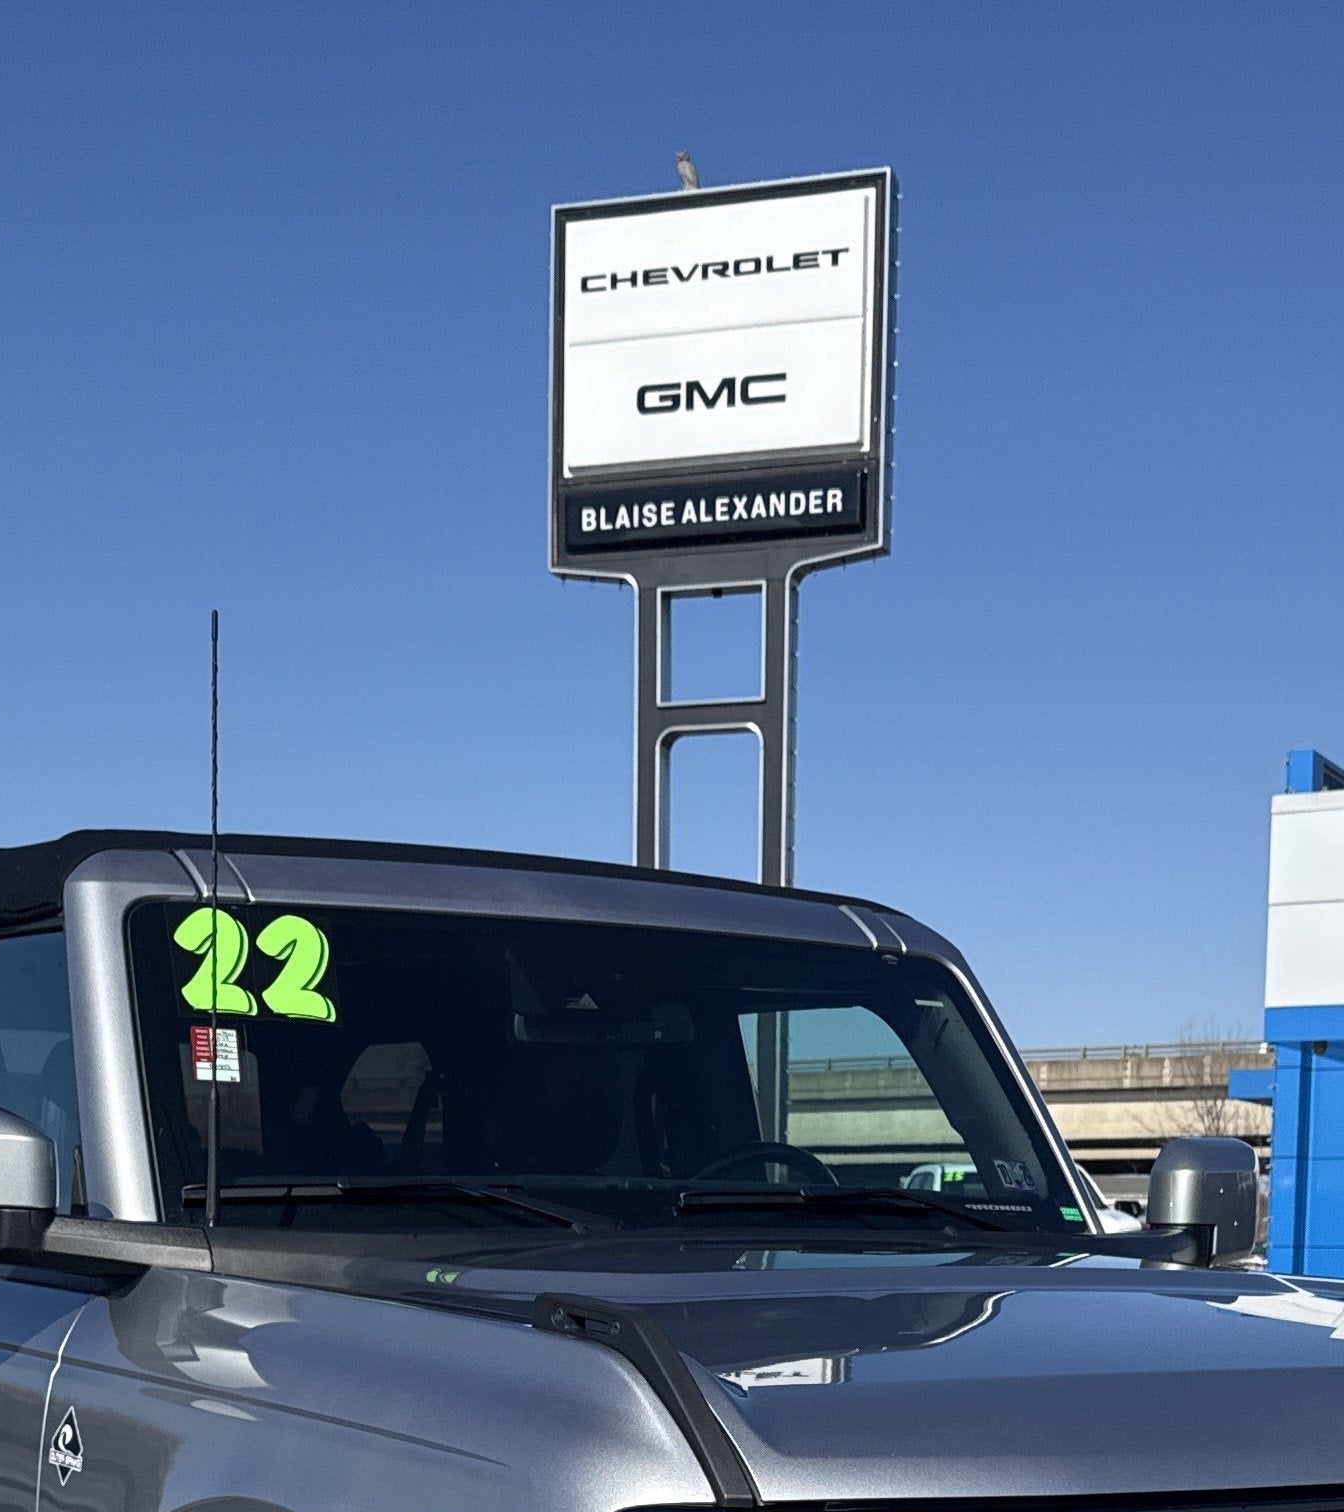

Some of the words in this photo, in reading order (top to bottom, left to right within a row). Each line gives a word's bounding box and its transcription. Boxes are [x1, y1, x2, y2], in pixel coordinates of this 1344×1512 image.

[581, 247, 849, 292] CHEVROLET
[636, 372, 787, 415] GMC
[582, 501, 675, 531] BLAISE
[681, 488, 843, 524] ALEXANDER
[173, 907, 335, 1022] 22
